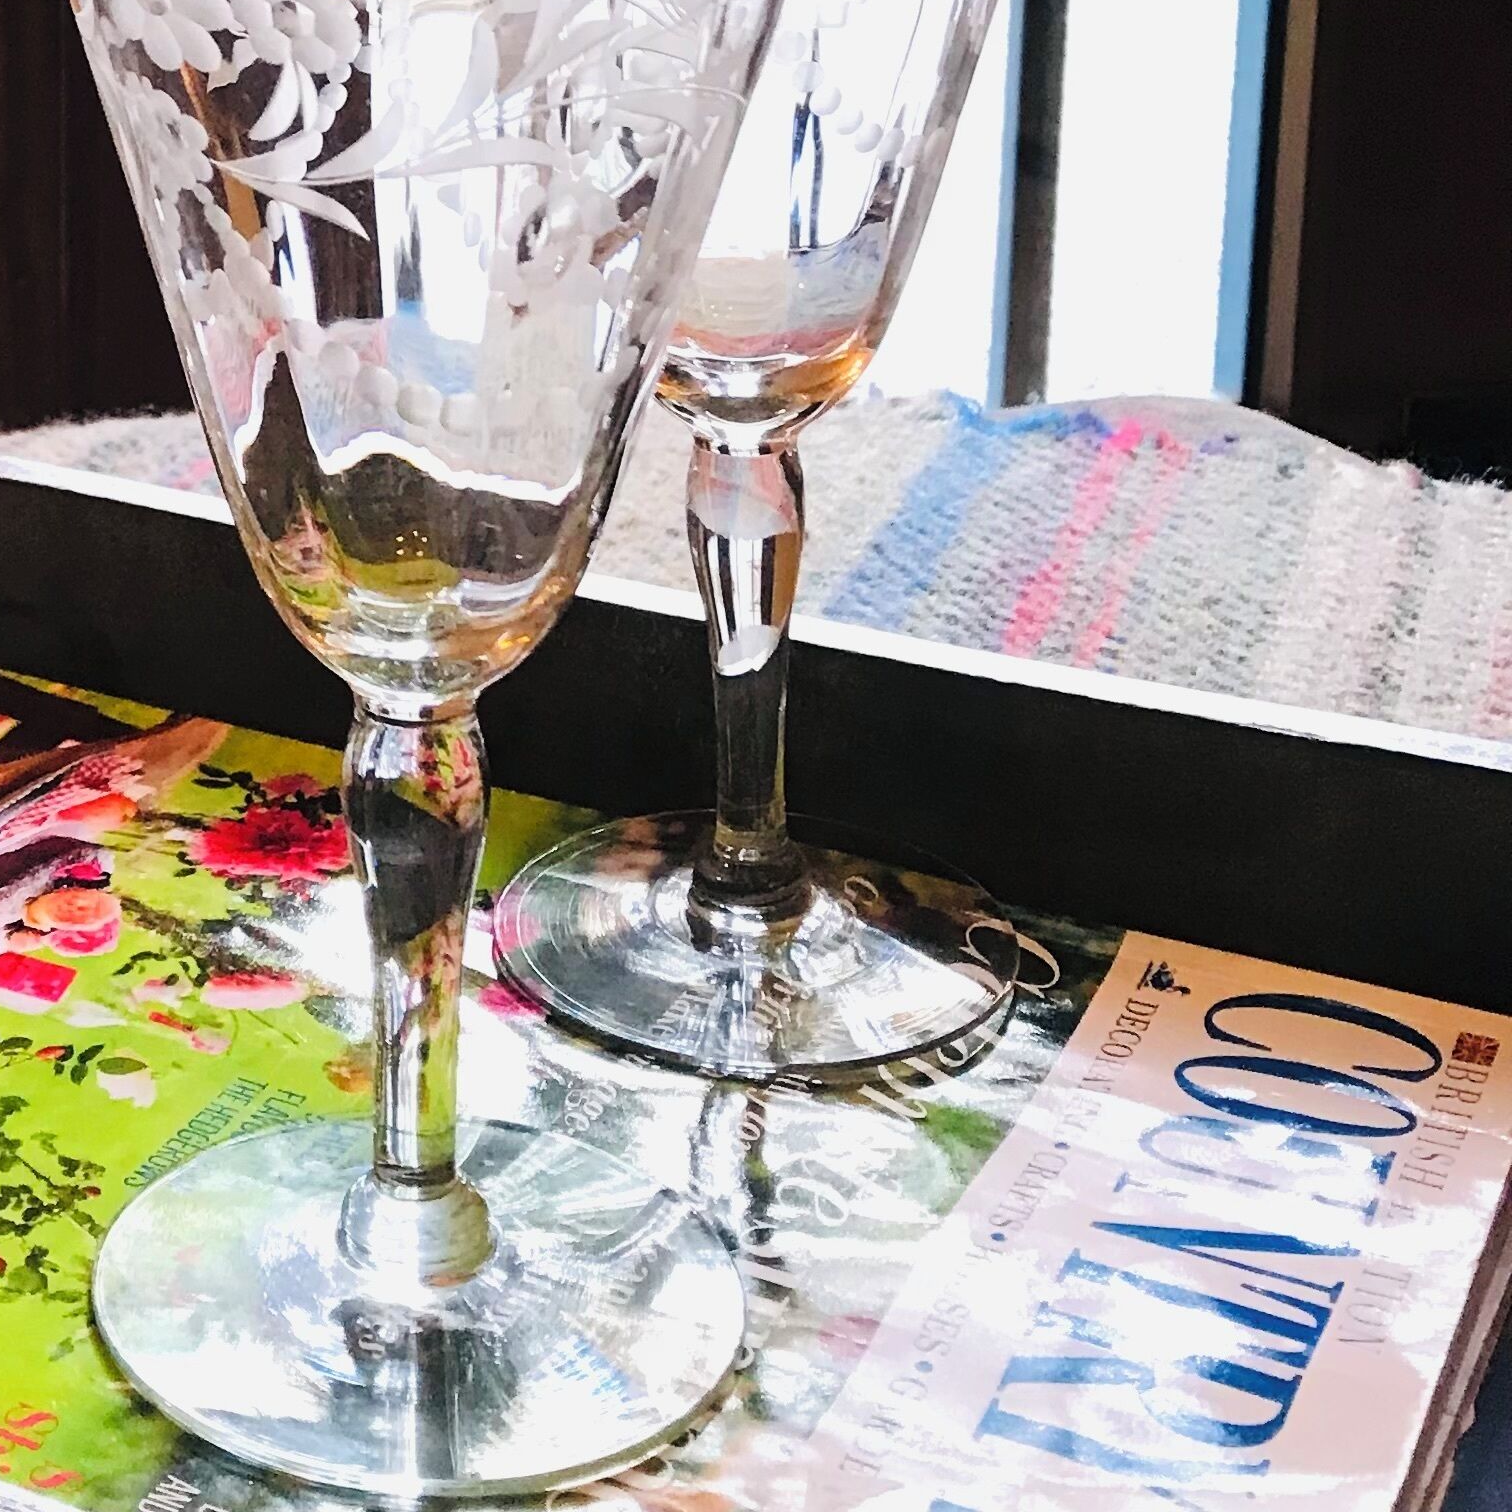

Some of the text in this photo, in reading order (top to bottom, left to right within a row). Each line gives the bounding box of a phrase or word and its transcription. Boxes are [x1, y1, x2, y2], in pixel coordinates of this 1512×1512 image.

[123, 1076, 269, 1188] THE HEDGEROWS
[988, 1152, 1068, 1232] CRAFTS
[1338, 1062, 1492, 1356] BRITISH ETION
